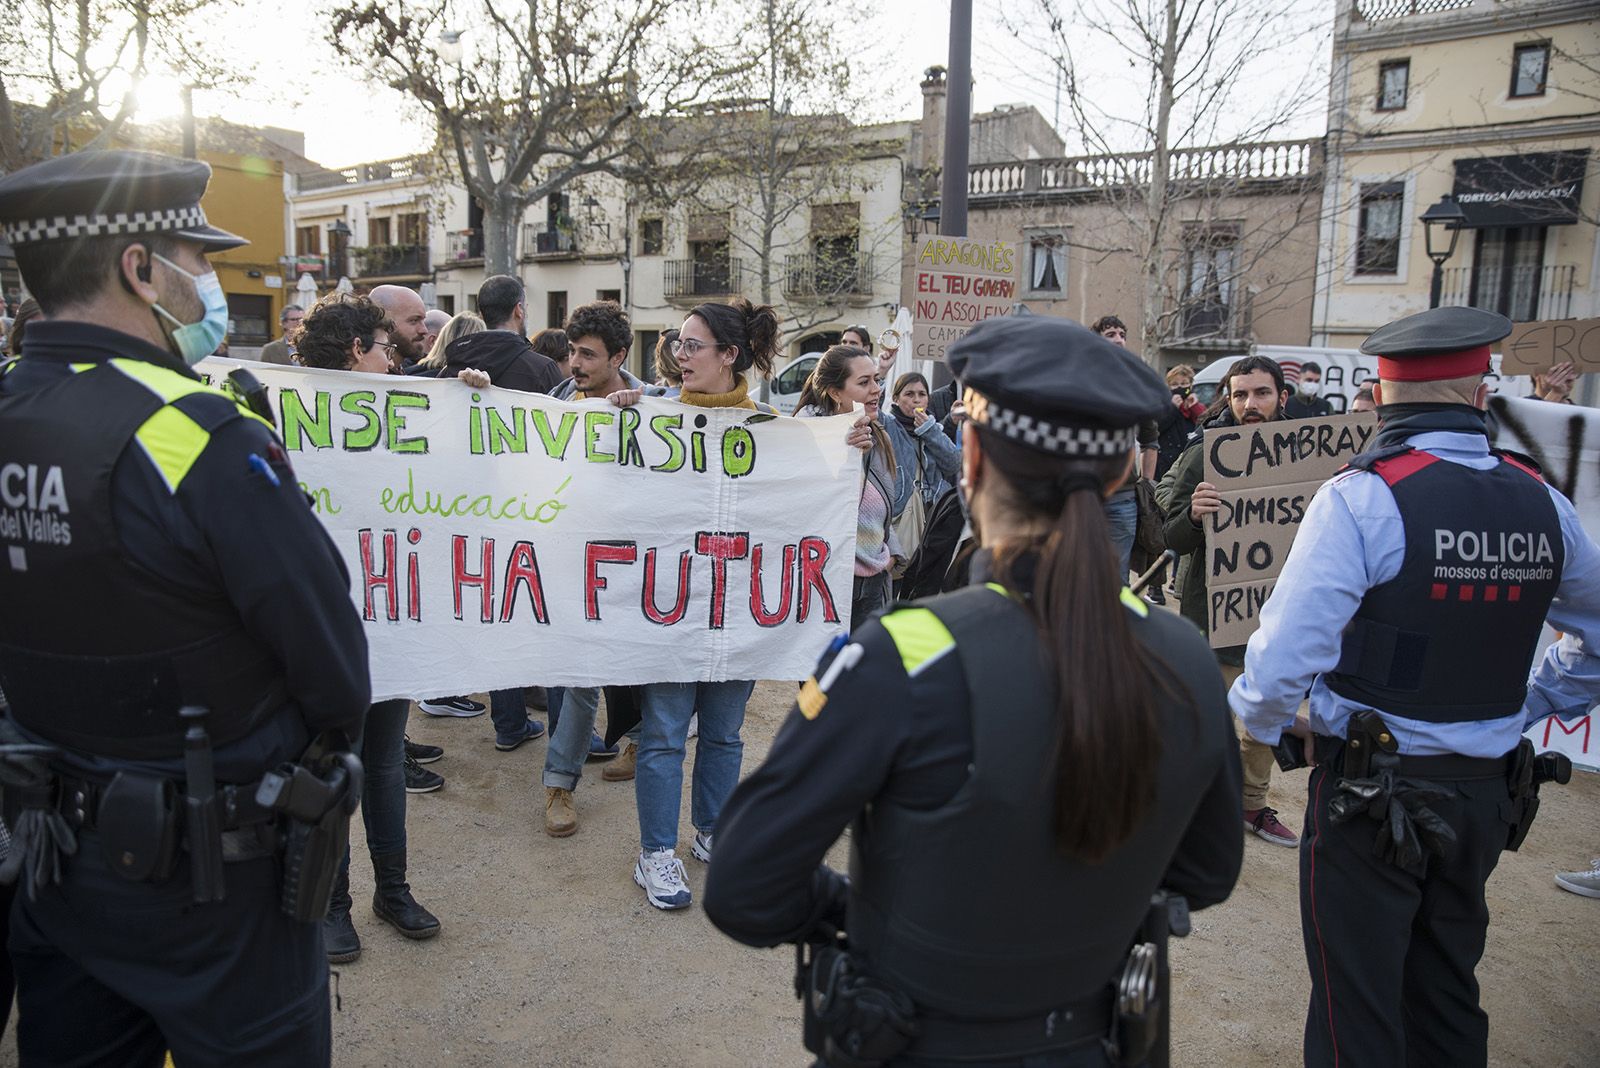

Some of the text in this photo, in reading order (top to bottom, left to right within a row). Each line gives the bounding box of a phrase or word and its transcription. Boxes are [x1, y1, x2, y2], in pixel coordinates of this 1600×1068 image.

[918, 273, 1015, 298] EL TEU GOVERN
[917, 300, 937, 320] NO
[928, 326, 971, 342] CAMB
[1210, 424, 1372, 477] CAMBRAY
[0, 462, 69, 514] CIA
[379, 468, 572, 523] educació
[0, 507, 72, 546] del Vallès
[1212, 495, 1315, 533] DIMISS
[1213, 540, 1273, 576] NO
[1434, 528, 1554, 563] POLICIA
[452, 533, 550, 625] HA
[584, 531, 841, 630] FUTUR
[1434, 565, 1487, 579] mossos
[1212, 586, 1274, 632] PRIV
